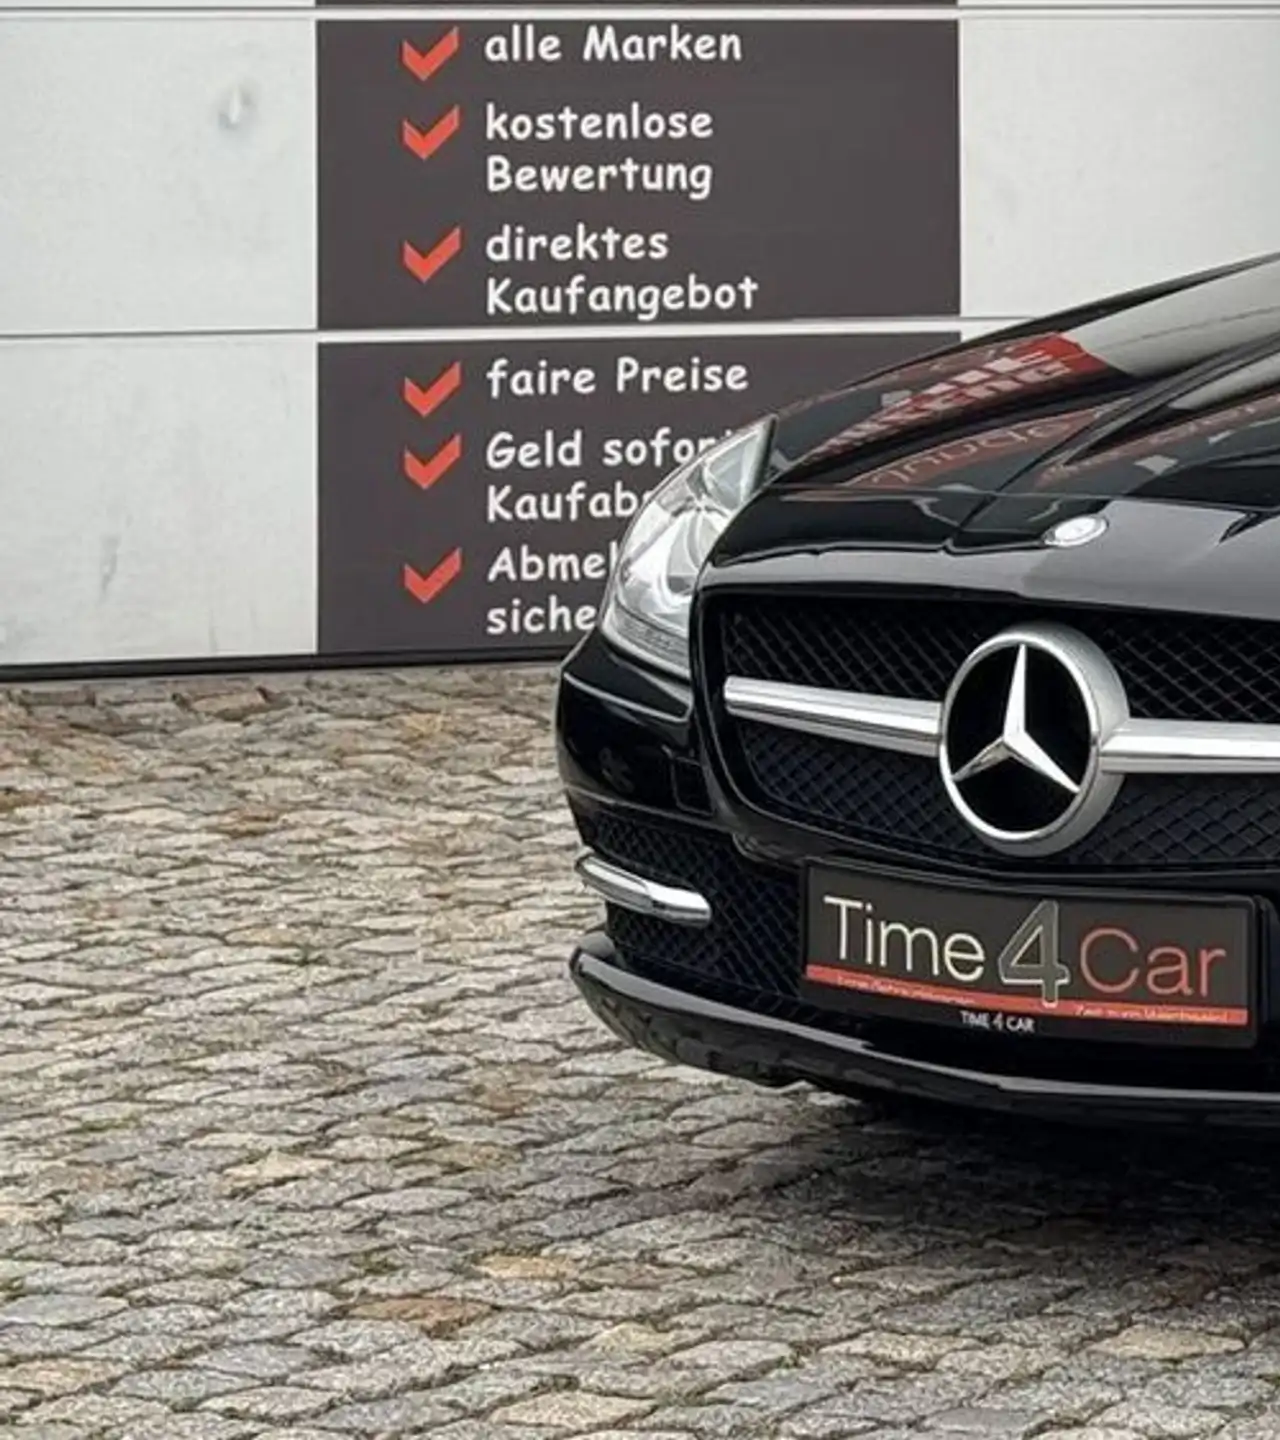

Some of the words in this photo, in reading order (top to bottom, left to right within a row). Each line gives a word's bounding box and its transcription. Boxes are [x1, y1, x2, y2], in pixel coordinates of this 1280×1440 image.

[485, 24, 562, 62] alle
[583, 24, 743, 62] Marken
[486, 101, 714, 140] kostenlose
[487, 155, 713, 200] Bewertung
[486, 223, 669, 262] direktes
[487, 273, 759, 322] Kaufangebot
[486, 360, 597, 399] faire
[616, 356, 749, 394] Preise
[486, 428, 583, 470] Geld
[602, 425, 733, 467] sofor
[487, 479, 655, 524] Kaufab
[487, 540, 618, 582] Abmel
[486, 593, 597, 635] siche
[823, 894, 985, 982] Time
[998, 899, 1070, 1008] 4
[1079, 927, 1227, 997] Car
[959, 1009, 991, 1029] TIME
[1006, 1015, 1036, 1034] CAR
